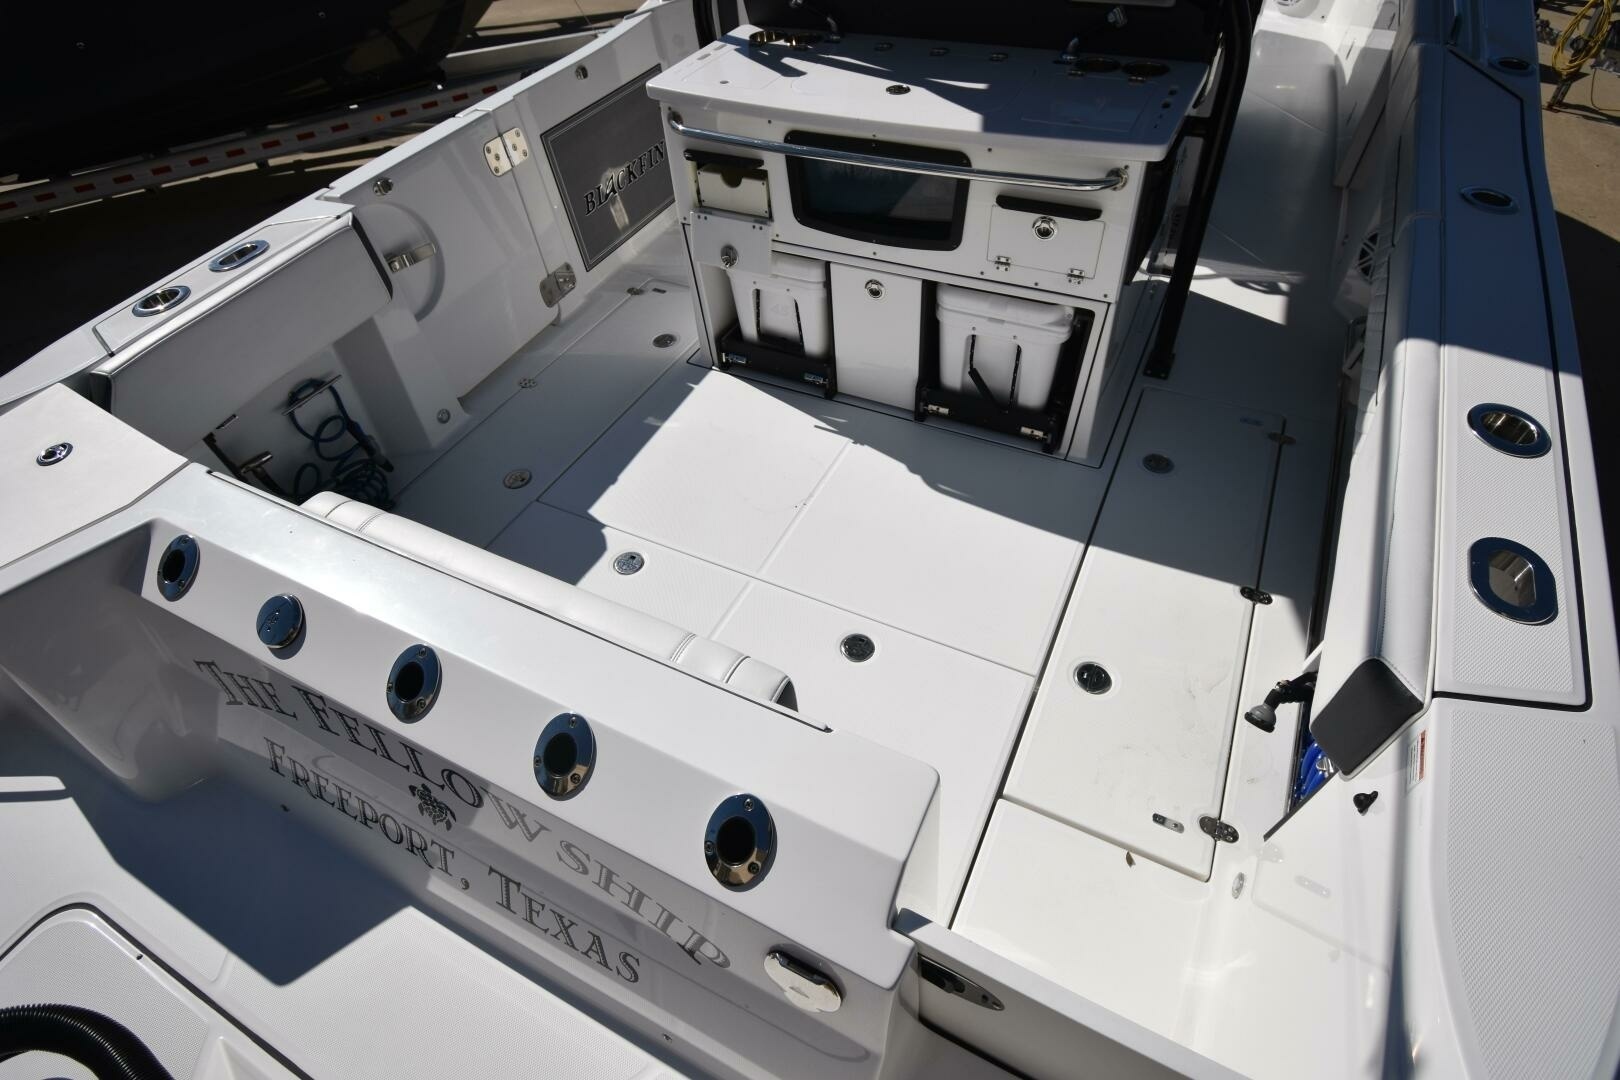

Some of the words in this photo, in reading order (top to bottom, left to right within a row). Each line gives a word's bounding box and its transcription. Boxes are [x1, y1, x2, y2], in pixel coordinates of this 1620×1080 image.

[583, 139, 665, 217] BLACKFIN
[193, 659, 298, 720] THE
[263, 736, 470, 891] FREEPORT,
[488, 865, 640, 983] TEXAS
